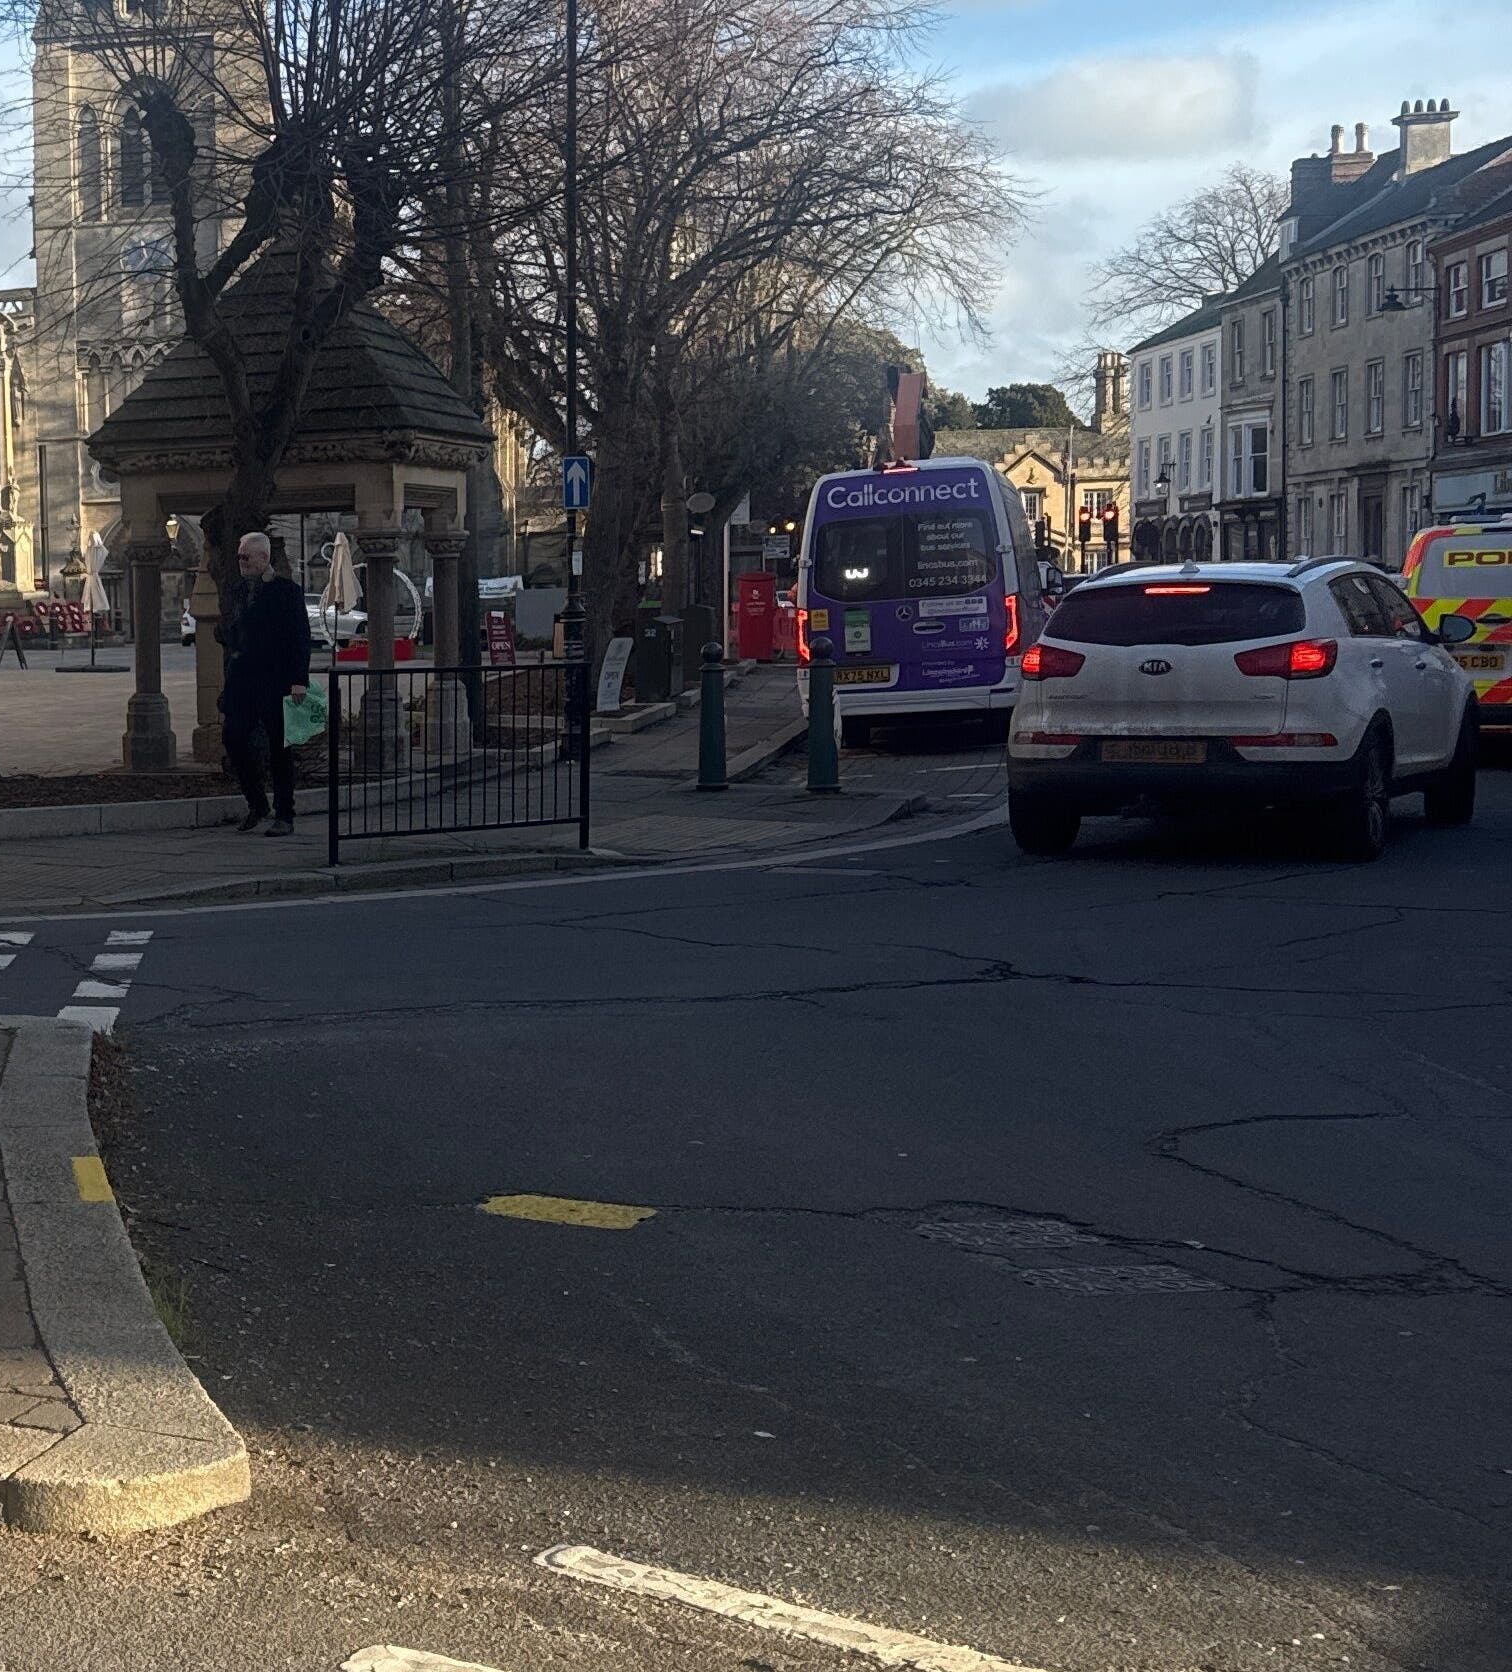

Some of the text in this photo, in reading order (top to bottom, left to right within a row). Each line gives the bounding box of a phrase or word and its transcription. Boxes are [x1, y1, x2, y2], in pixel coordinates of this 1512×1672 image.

[827, 478, 979, 508] Callconnect
[918, 521, 973, 532] Find out more
[926, 532, 964, 541] about our
[920, 543, 936, 552] bus
[917, 559, 978, 570] lincsbus.com
[1448, 552, 1512, 566] PO
[908, 576, 937, 588] 0345
[938, 575, 958, 586] 234
[1143, 662, 1167, 673] KIA
